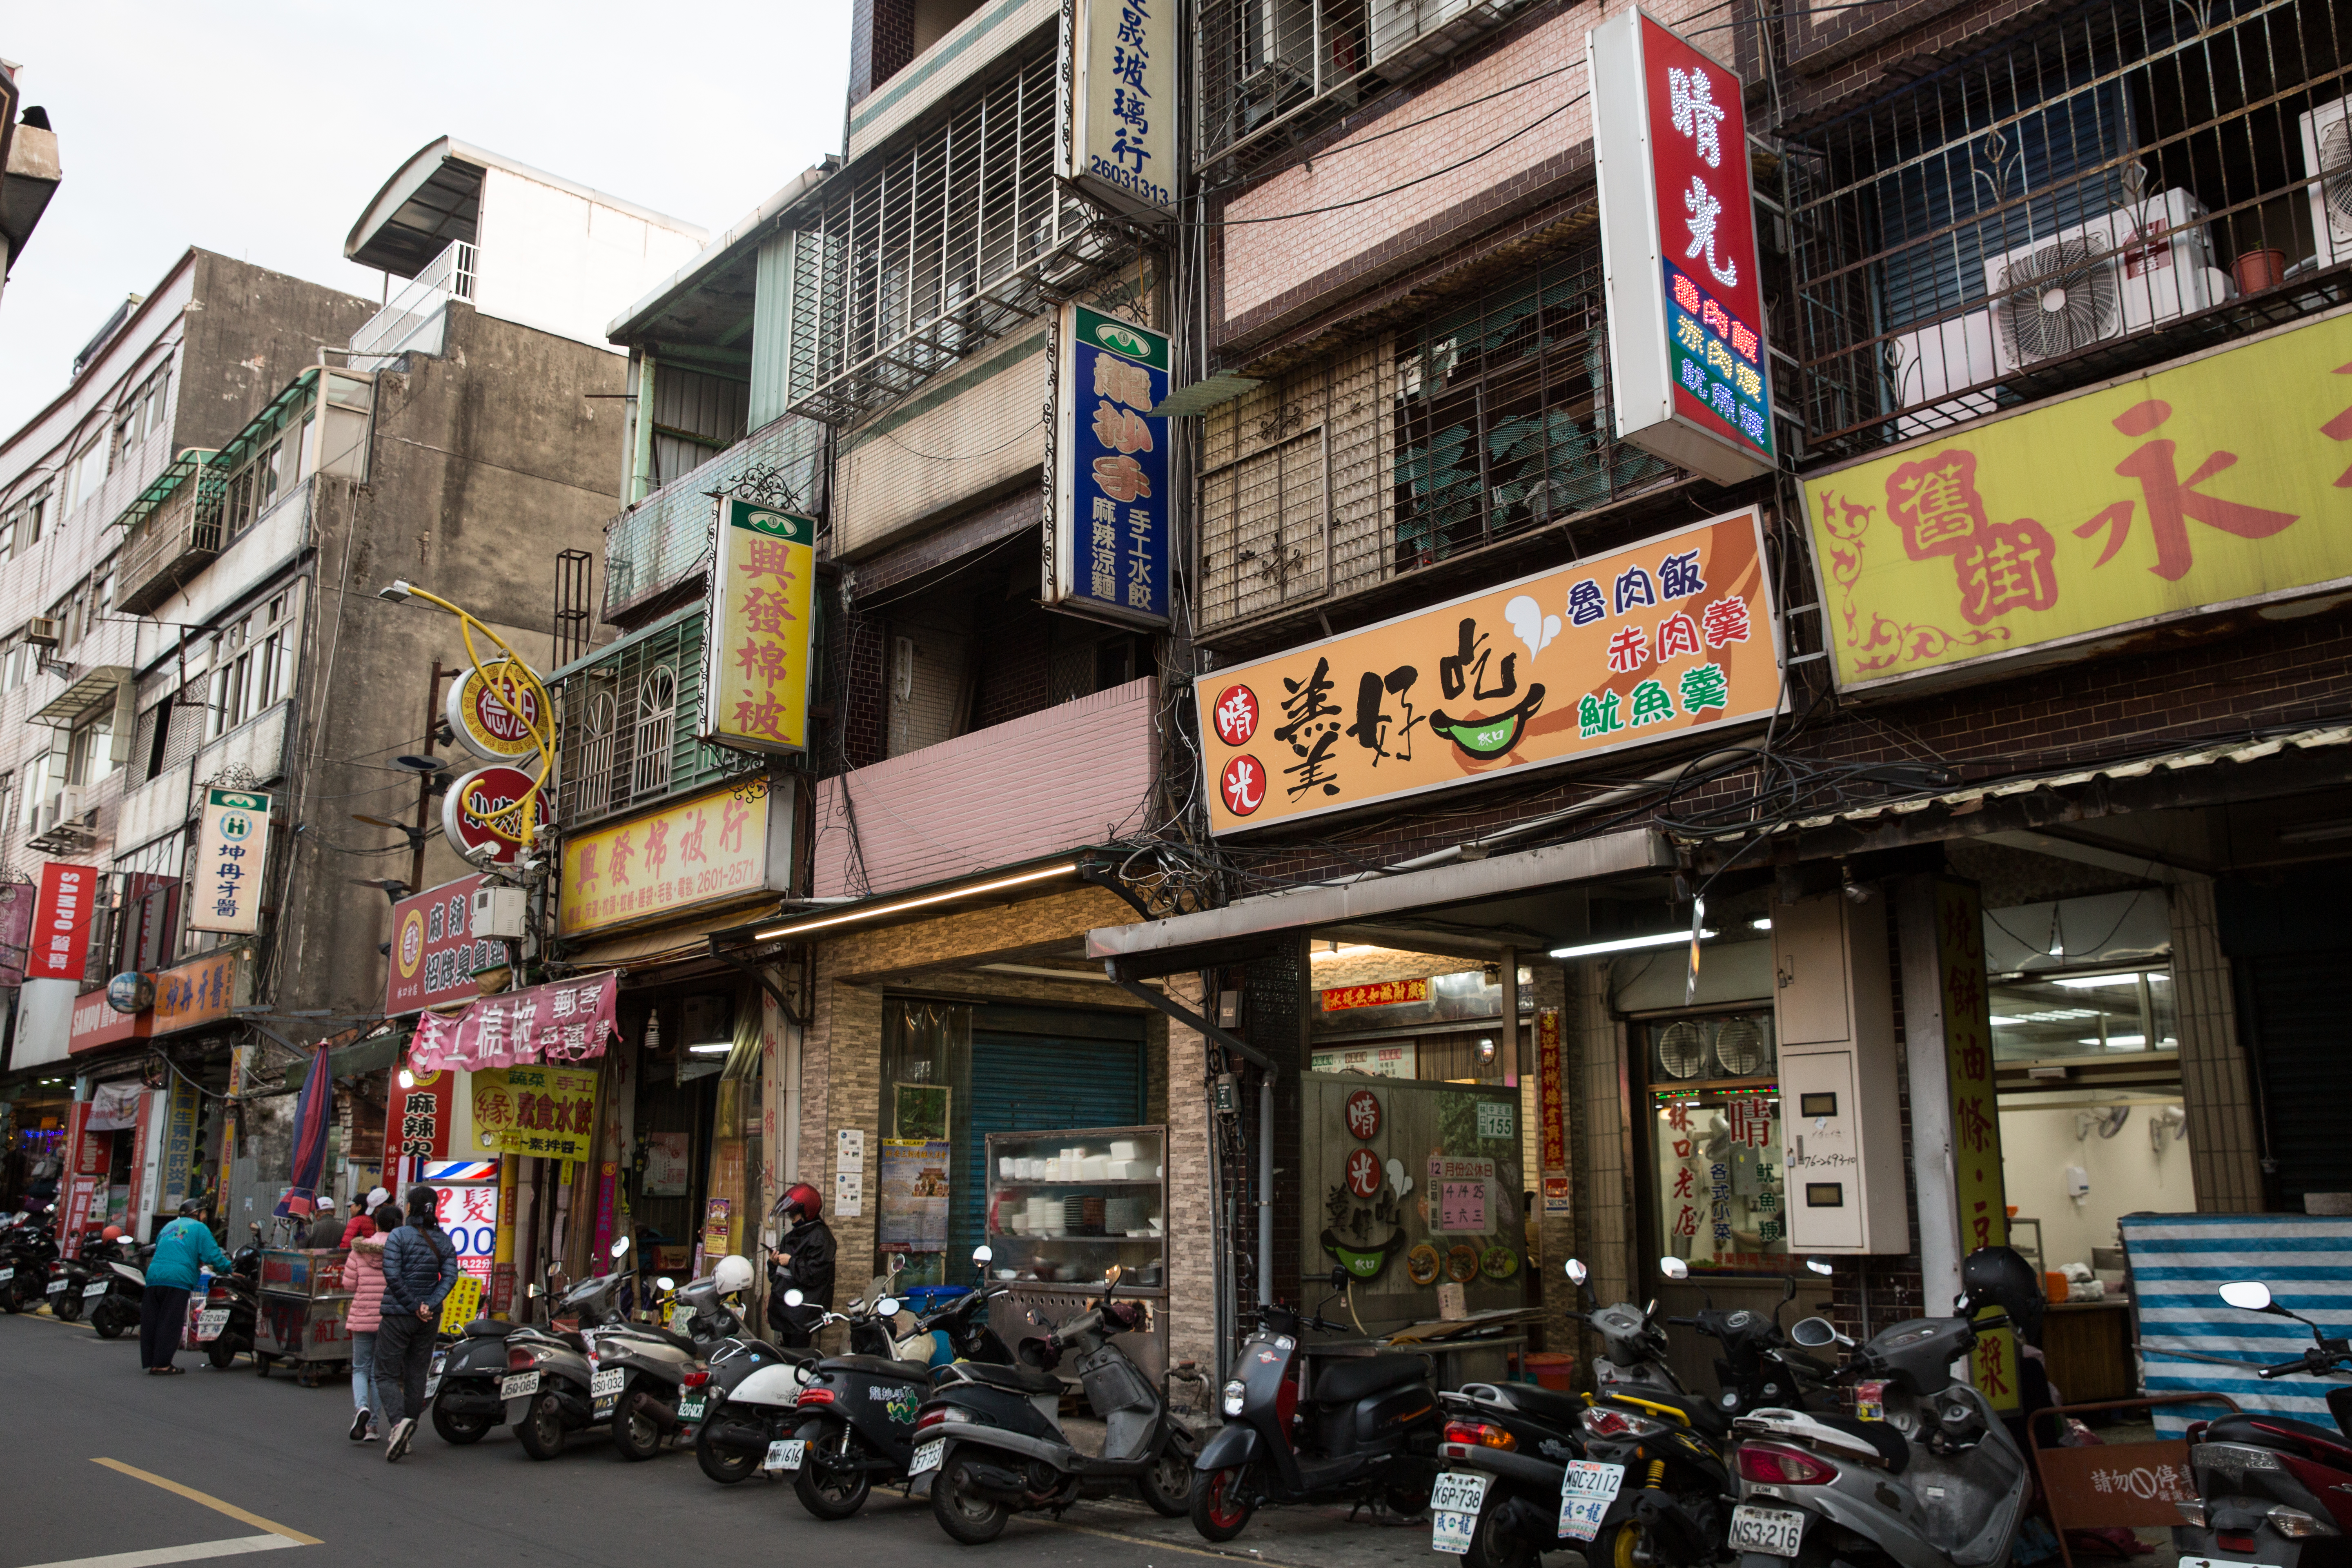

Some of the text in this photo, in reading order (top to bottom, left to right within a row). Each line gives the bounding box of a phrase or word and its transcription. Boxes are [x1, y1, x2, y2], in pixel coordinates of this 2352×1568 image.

[1091, 154, 1168, 206] 26031313
[1668, 67, 1737, 287] 晴光
[2072, 359, 2352, 581] 永
[1092, 497, 1116, 602] 麻辣涼麵
[1129, 509, 1152, 610] 手工水餃
[1899, 463, 2043, 616] 舊街
[1566, 548, 1706, 627] 魯肉飯
[733, 539, 797, 741] 興發棉被
[1609, 597, 1750, 673] 赤肉羹
[1578, 664, 1728, 739] 魷魚羹
[1220, 690, 1262, 811] 晴光
[1477, 729, 1504, 747] 林口
[576, 796, 749, 895] 興發棉被行
[53, 872, 80, 930] SAMPO
[212, 844, 246, 917] 坤冉牙醫
[697, 858, 754, 893] 2601-2571
[428, 889, 474, 943] 麻辣
[166, 964, 224, 1017] 坤冉牙醫
[397, 983, 417, 999] 林口分店
[72, 1003, 102, 1037] SAMPO
[509, 1071, 545, 1087] 蔬菜
[556, 1076, 592, 1093] 手工
[477, 1093, 510, 1123] 緣
[517, 1091, 592, 1135] 素食水餃
[1490, 1118, 1511, 1134] 155
[1728, 1098, 1771, 1148] 晴
[387, 1145, 397, 1176] 林口店
[1350, 1095, 1378, 1193] 晴光
[1431, 1163, 1492, 1177] 12 月份公休日
[1669, 1101, 1695, 1236] 林口老店
[1431, 1180, 1484, 1201] 日期 4 14 25
[1444, 1212, 1454, 1224] 三
[1459, 1208, 1469, 1223] 六
[1472, 1209, 1483, 1222] 三
[1711, 1164, 1731, 1239] 各式小菜
[440, 1227, 496, 1256] 00
[870, 1386, 904, 1402] 龍抄手
[2092, 1469, 2129, 1494] 請勿
